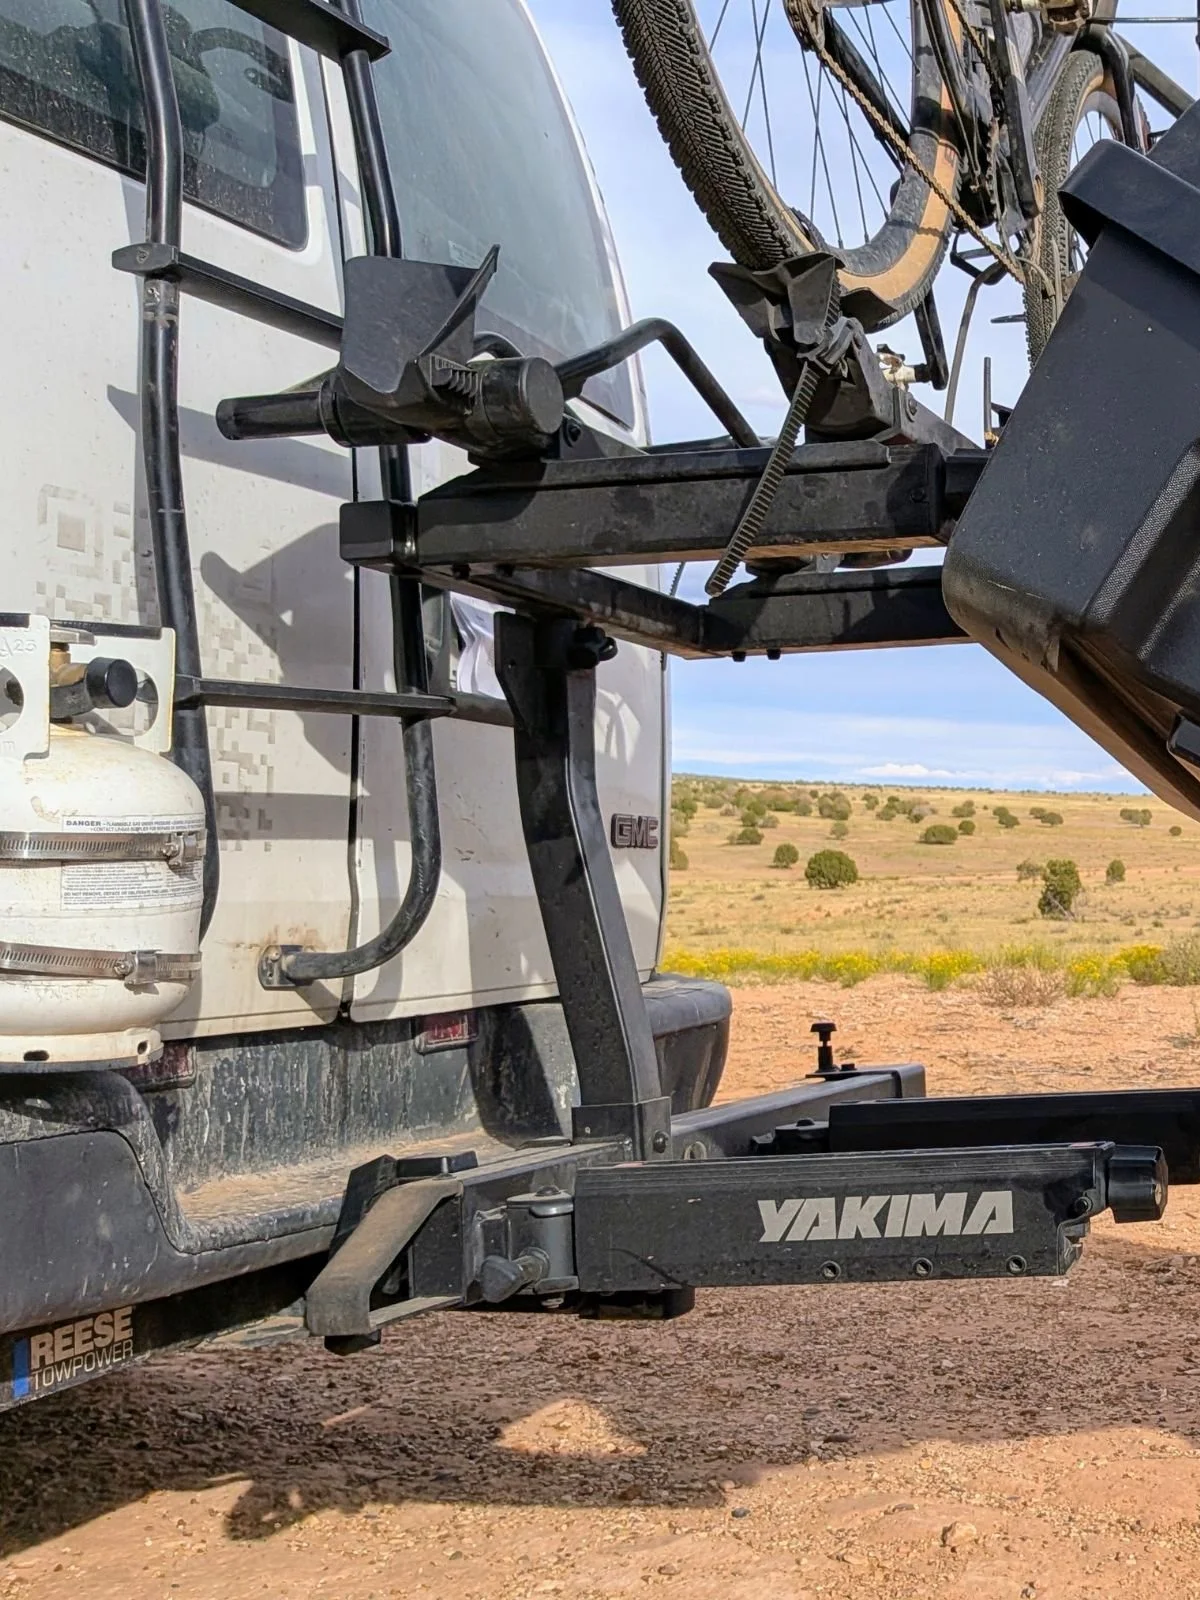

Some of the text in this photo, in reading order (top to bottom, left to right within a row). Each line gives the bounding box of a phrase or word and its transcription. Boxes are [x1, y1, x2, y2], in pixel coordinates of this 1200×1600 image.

[611, 813, 659, 849] GMC
[758, 1191, 1014, 1242] YAKIMA
[30, 1306, 133, 1369] REESE
[31, 1339, 133, 1390] TOWPOWER
